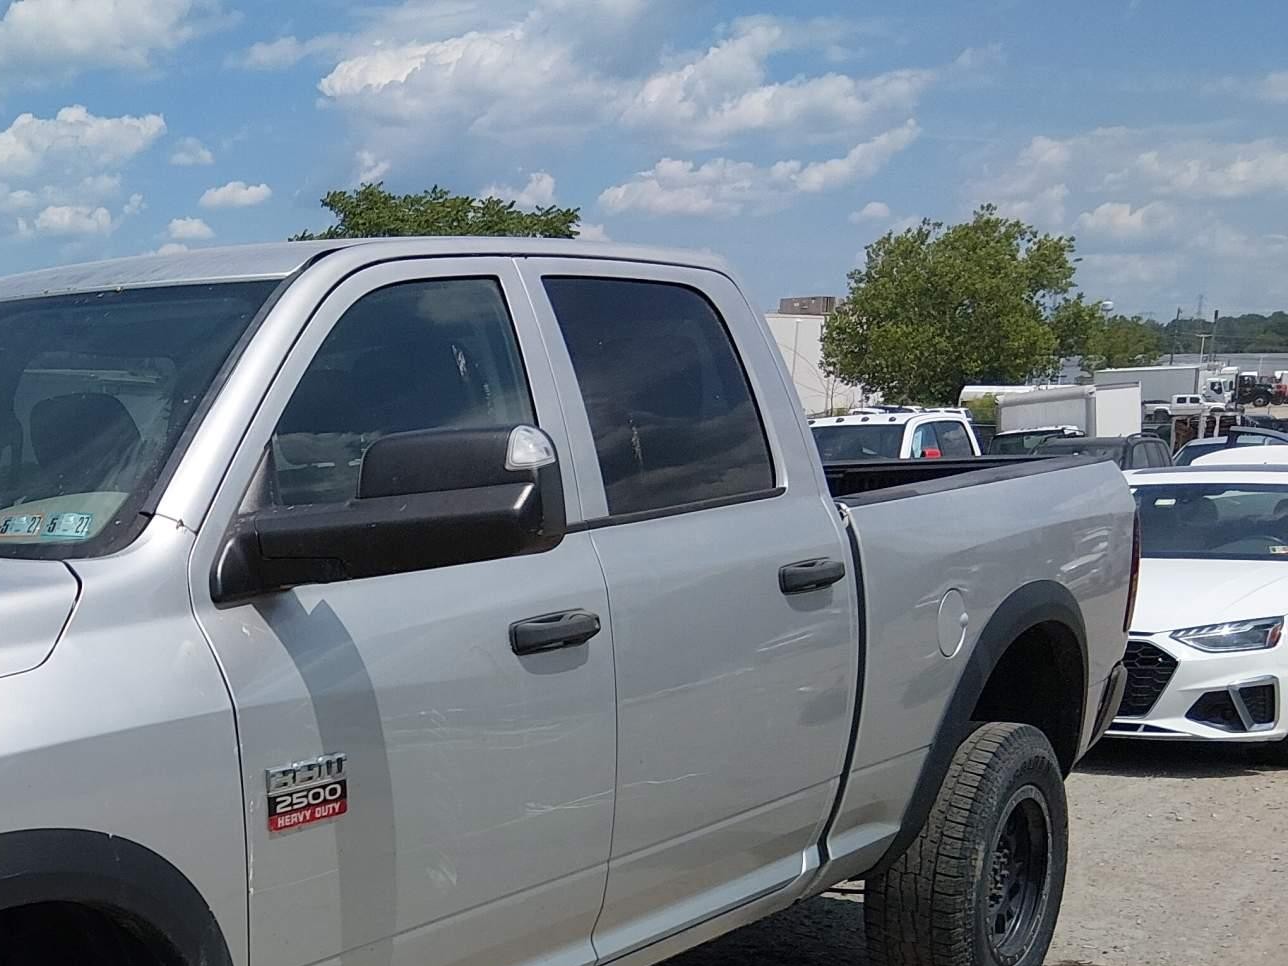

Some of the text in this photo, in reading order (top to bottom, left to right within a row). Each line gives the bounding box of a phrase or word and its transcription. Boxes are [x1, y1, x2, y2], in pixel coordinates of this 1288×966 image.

[26, 516, 43, 535] 27
[75, 516, 90, 534] 27
[276, 783, 342, 813] 2500
[277, 800, 341, 828] HEAVY DUTY
